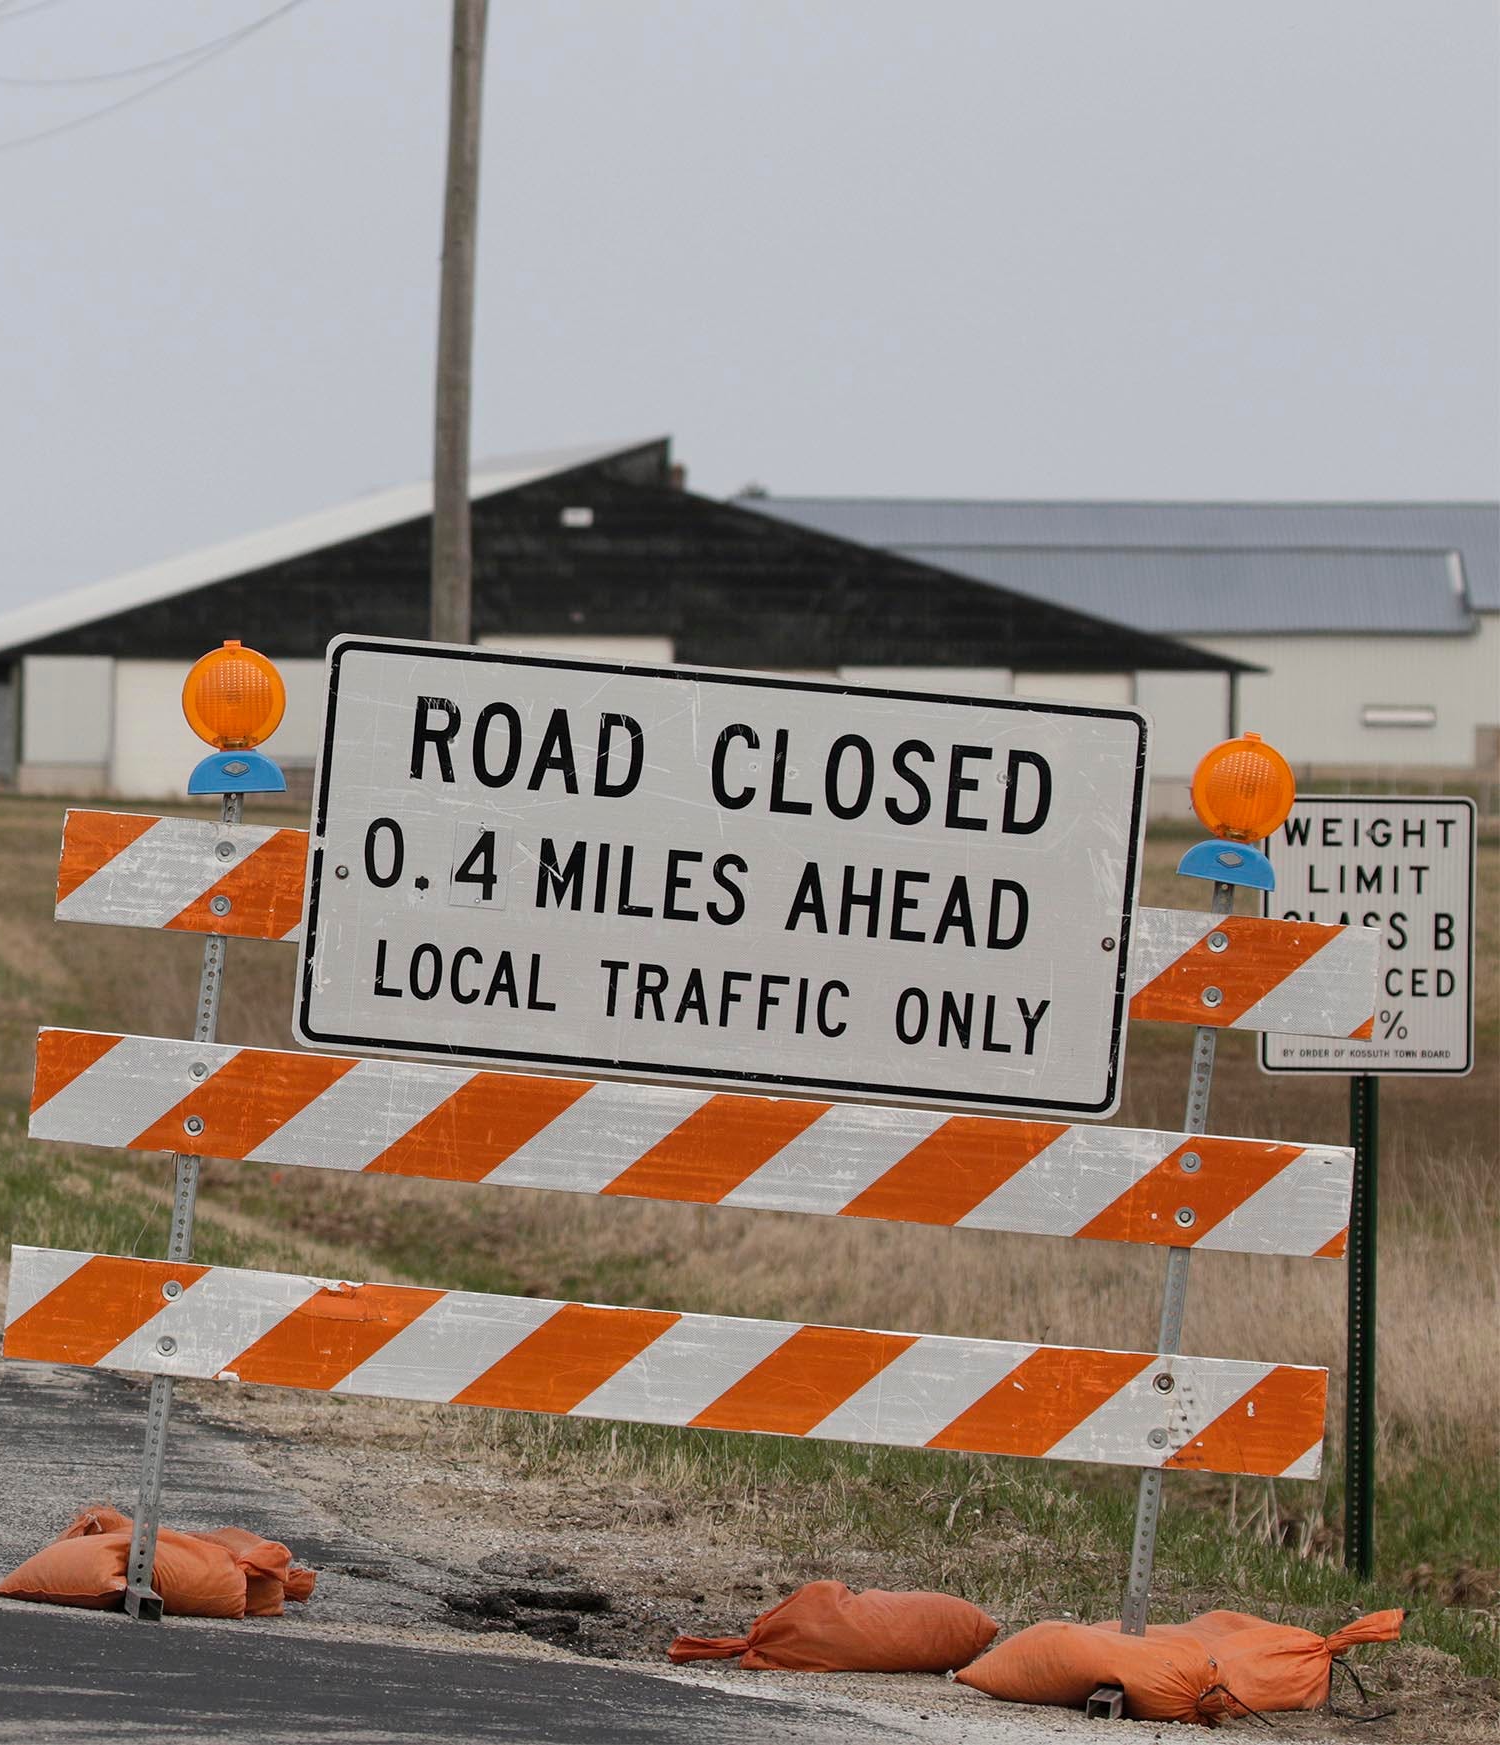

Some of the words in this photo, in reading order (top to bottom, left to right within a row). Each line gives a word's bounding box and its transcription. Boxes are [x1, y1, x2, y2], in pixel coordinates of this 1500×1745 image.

[409, 695, 645, 799] ROAD
[711, 723, 1053, 835] CLOSED
[1283, 817, 1457, 849] WEIGHT
[535, 837, 749, 926] MILES
[784, 861, 1029, 951] AHEAD
[1308, 864, 1430, 895] LIMIT
[1433, 912, 1456, 952] B
[373, 938, 557, 1012] LOCAL
[600, 959, 850, 1038] TRAFFIC
[895, 986, 1051, 1056] ONLY
[1282, 1048, 1295, 1059] BY
[1299, 1048, 1330, 1059] ORDER
[1334, 1049, 1346, 1059] OF
[1349, 1049, 1390, 1059] KOSSUTH
[1395, 1049, 1418, 1059] TOWN
[1421, 1050, 1451, 1060] BOARD
